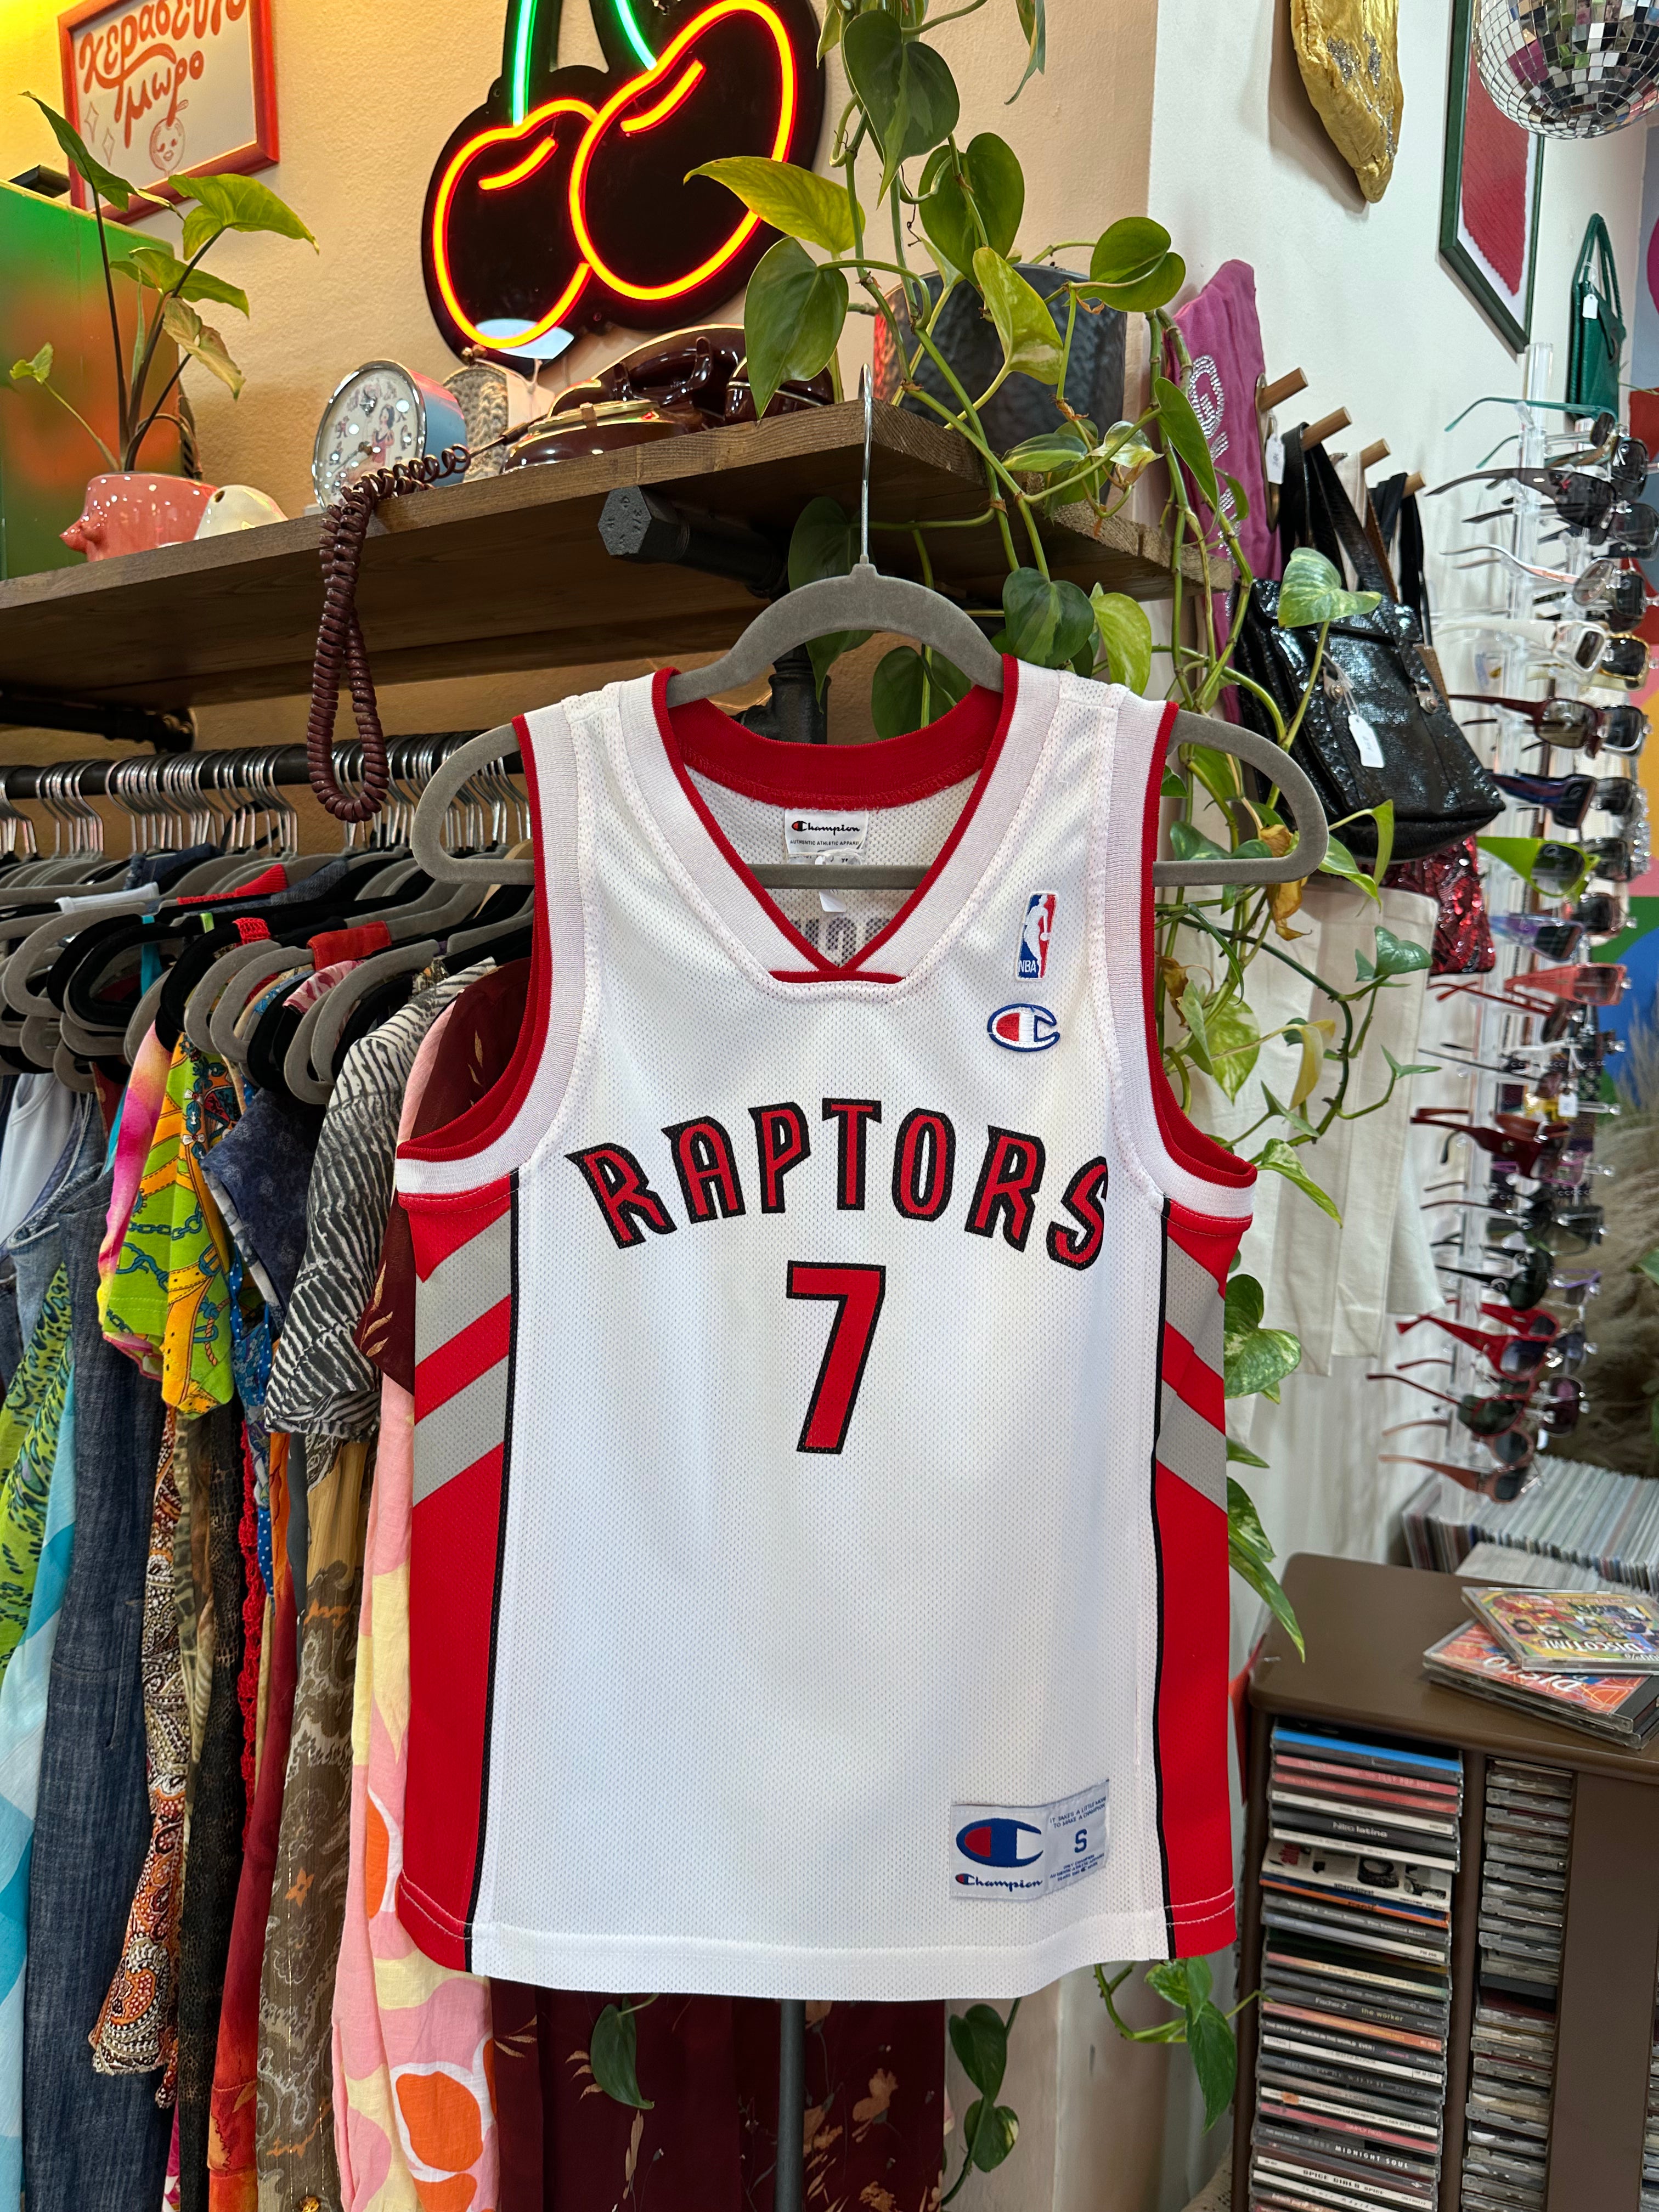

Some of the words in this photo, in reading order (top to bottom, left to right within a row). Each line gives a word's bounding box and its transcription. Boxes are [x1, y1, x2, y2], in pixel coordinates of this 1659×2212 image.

[792, 820, 860, 836] Champion
[1018, 960, 1037, 973] NBA
[564, 1097, 1110, 1271] RAPTORS
[786, 1260, 887, 1454] 7
[1074, 1829, 1087, 1853] S
[955, 1872, 1043, 1892] Champion
[1361, 2007, 1374, 2016] the
[1376, 2011, 1403, 2022] worker
[1335, 2145, 1381, 2162] MIDNIGHT
[1386, 2158, 1409, 2169] SOUL
